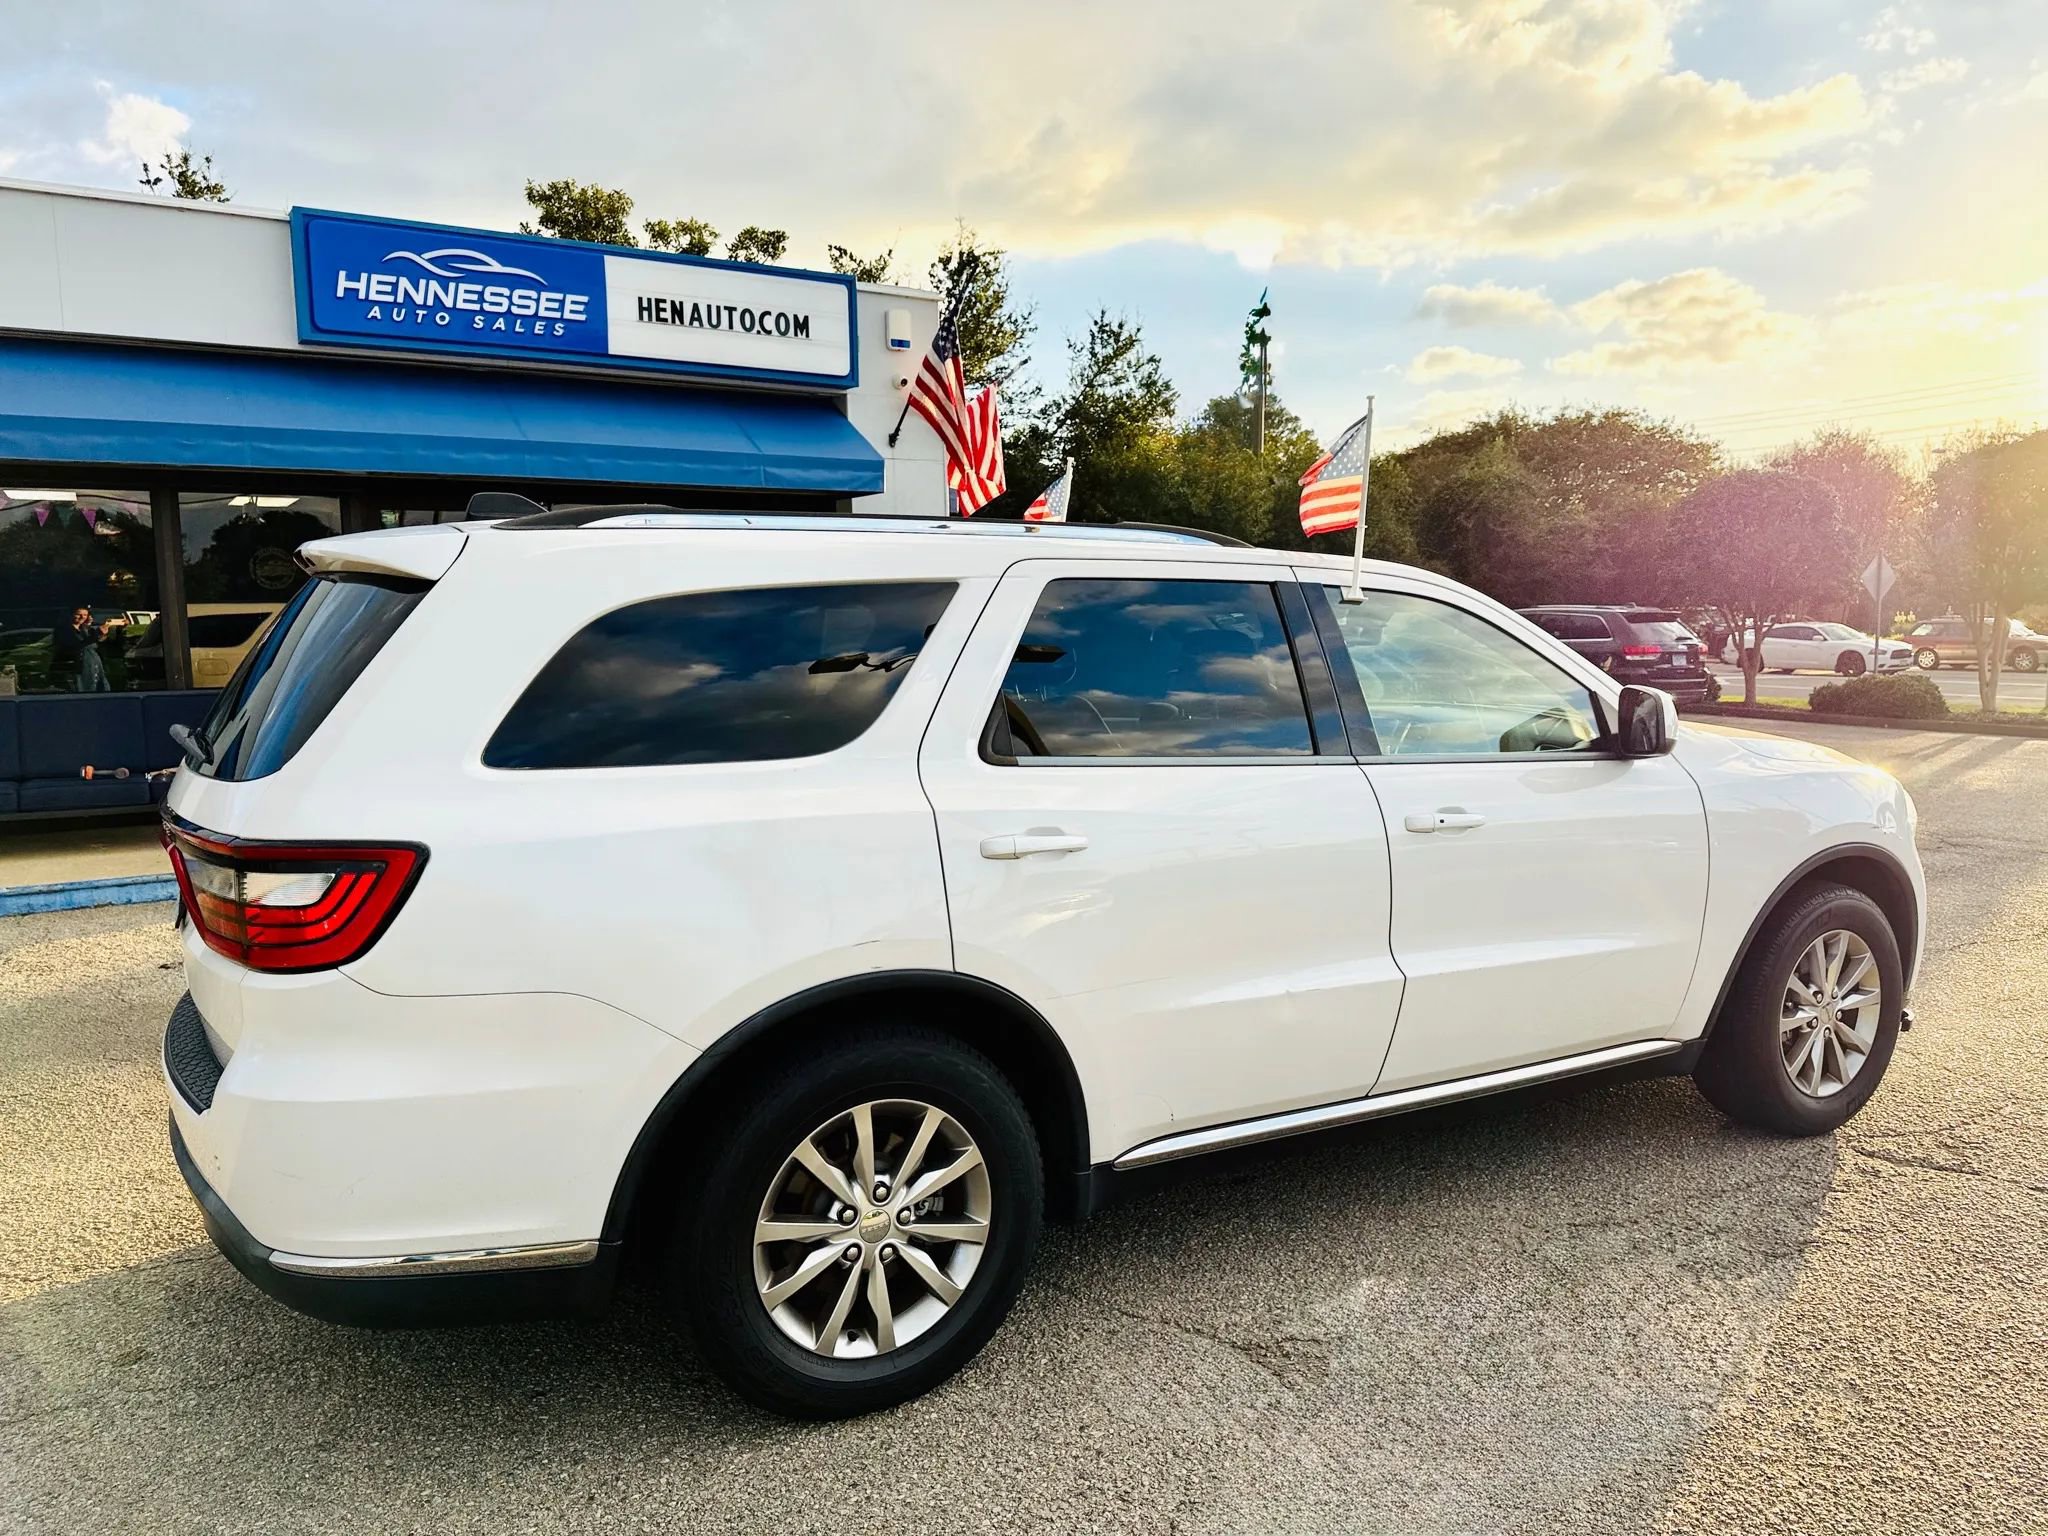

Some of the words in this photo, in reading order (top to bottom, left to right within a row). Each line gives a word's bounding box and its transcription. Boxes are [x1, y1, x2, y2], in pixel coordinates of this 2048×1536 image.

[336, 270, 589, 321] HENNESSEE
[367, 305, 450, 325] AUTO
[473, 316, 566, 337] SALES
[637, 296, 810, 339] HENAUTO.COM
